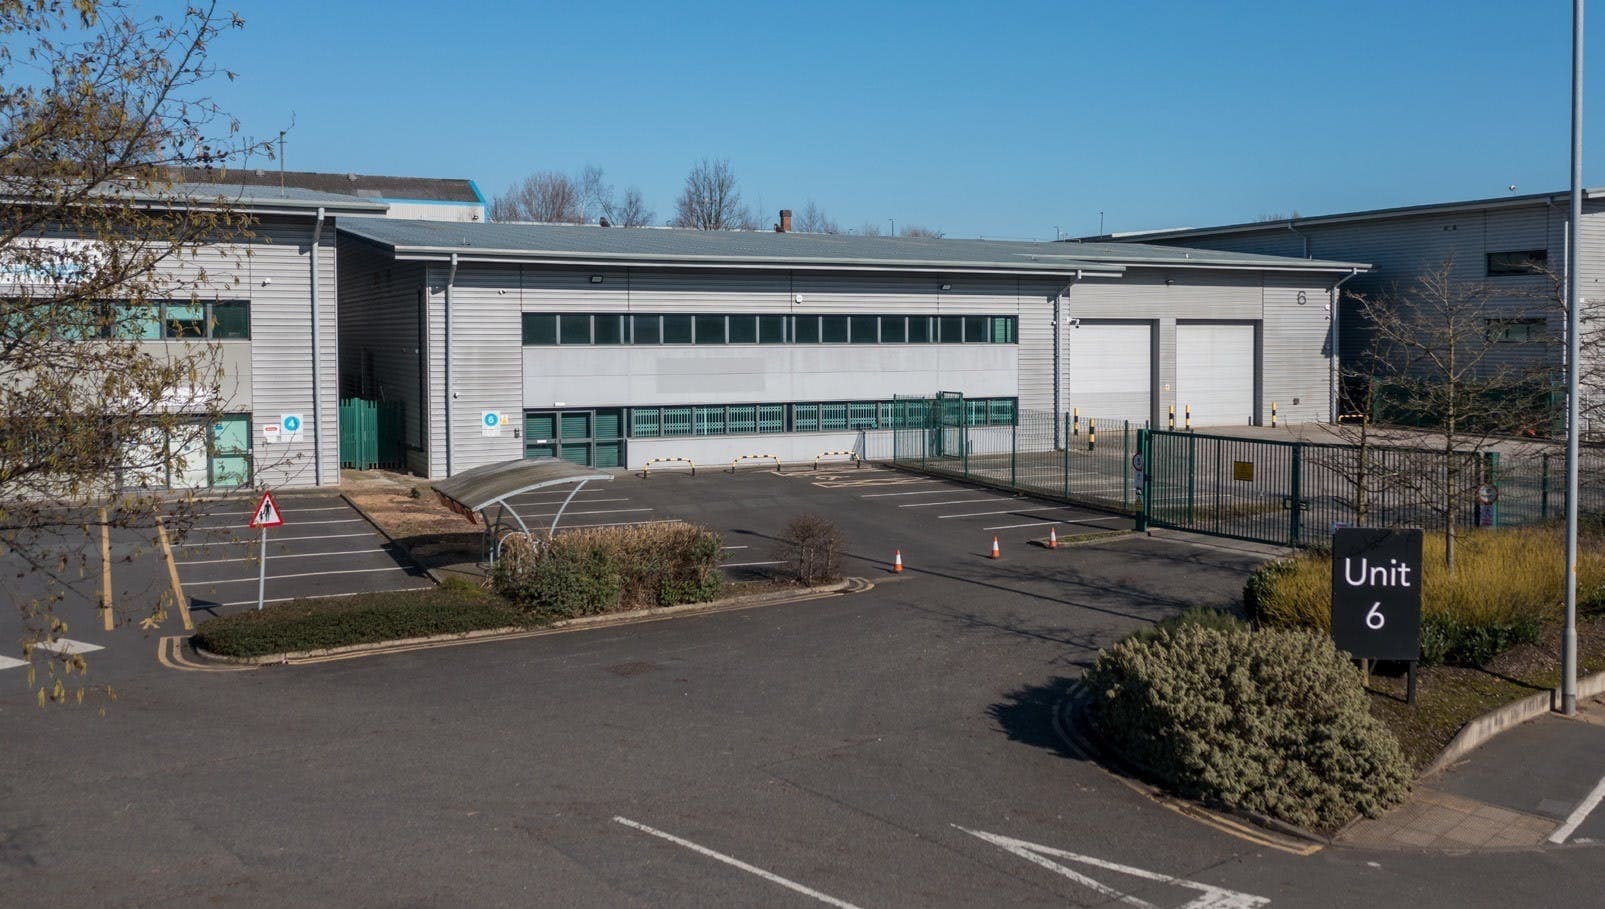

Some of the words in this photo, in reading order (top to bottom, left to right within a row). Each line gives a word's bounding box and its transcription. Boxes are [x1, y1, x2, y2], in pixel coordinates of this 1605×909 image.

[1297, 290, 1306, 305] 6
[1345, 557, 1411, 587] Unit
[1366, 601, 1385, 630] 6
